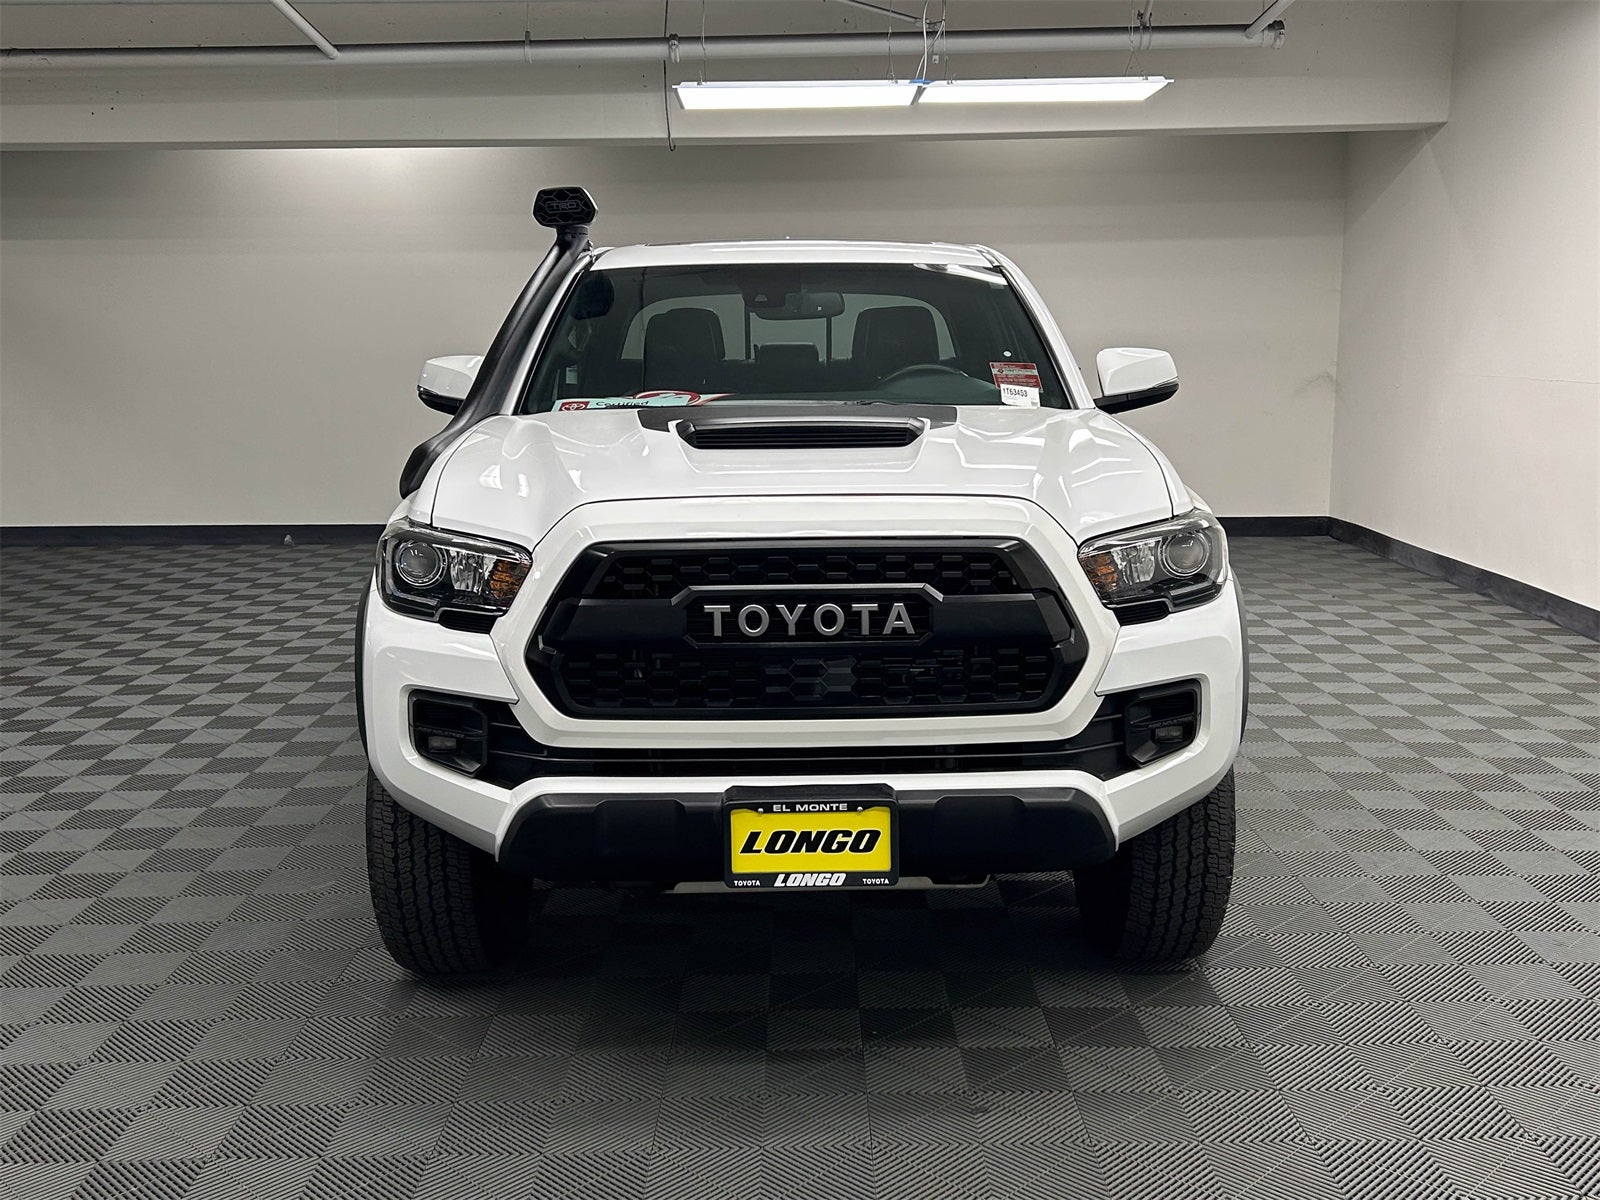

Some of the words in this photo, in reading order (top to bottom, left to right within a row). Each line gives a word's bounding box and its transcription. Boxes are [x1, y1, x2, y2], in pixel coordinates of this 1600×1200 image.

[703, 602, 916, 638] TOYOTA
[772, 804, 791, 812] EL
[795, 803, 848, 812] MONTE
[739, 828, 882, 855] LONGO
[733, 879, 761, 887] TOYOTA
[773, 873, 847, 888] LONGO
